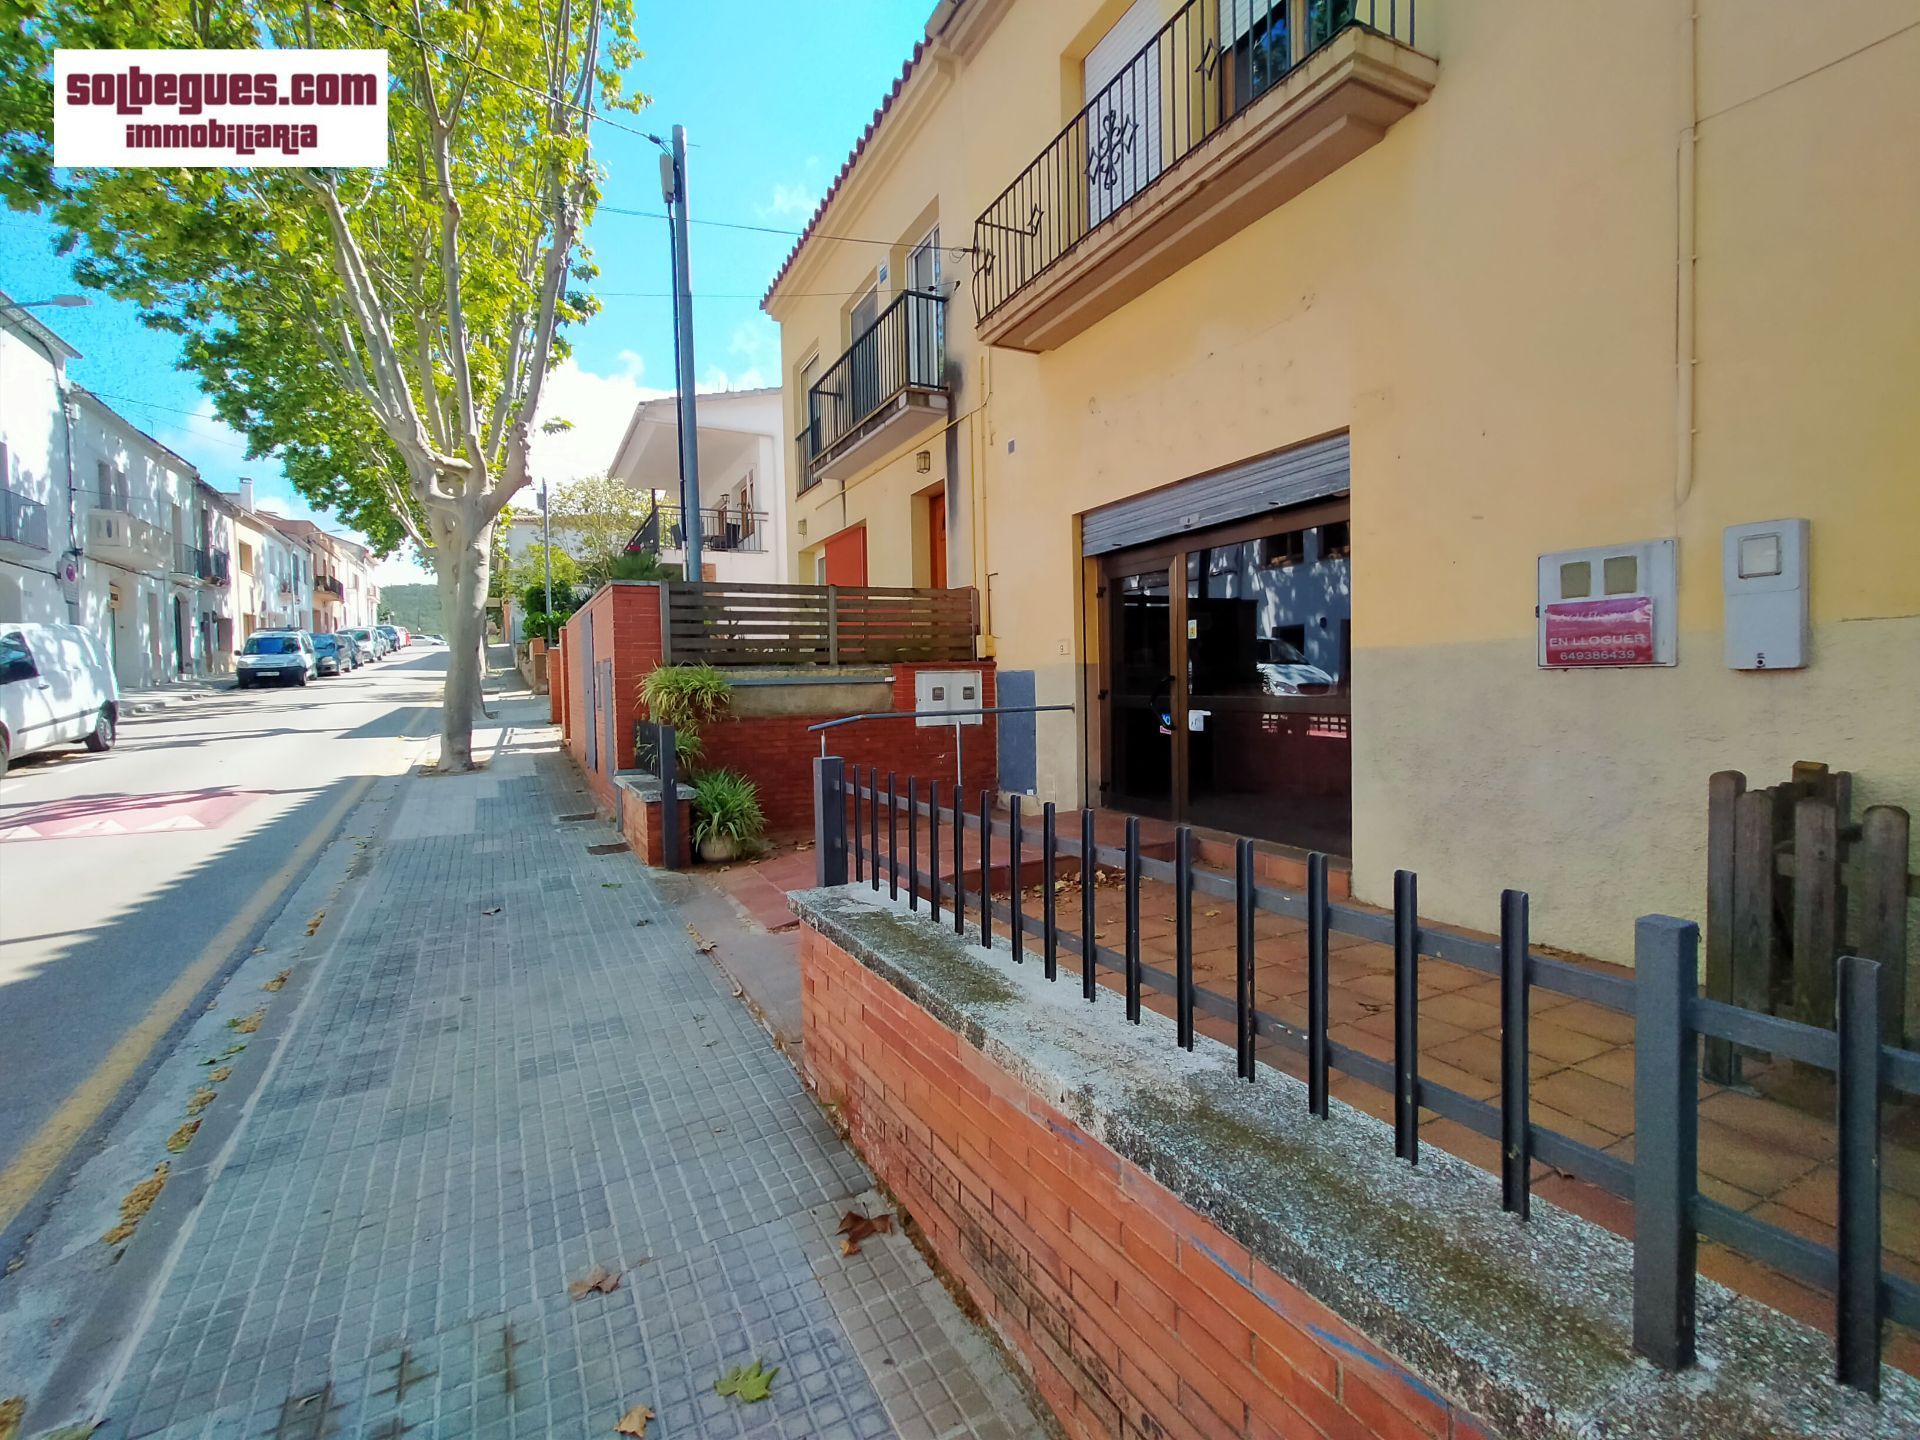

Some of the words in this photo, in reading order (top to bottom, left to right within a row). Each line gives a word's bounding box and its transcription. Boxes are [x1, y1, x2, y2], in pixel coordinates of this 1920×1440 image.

[1549, 637, 1569, 648] EN
[1571, 633, 1647, 646] LLOGUER
[1560, 649, 1636, 660] 649386439
